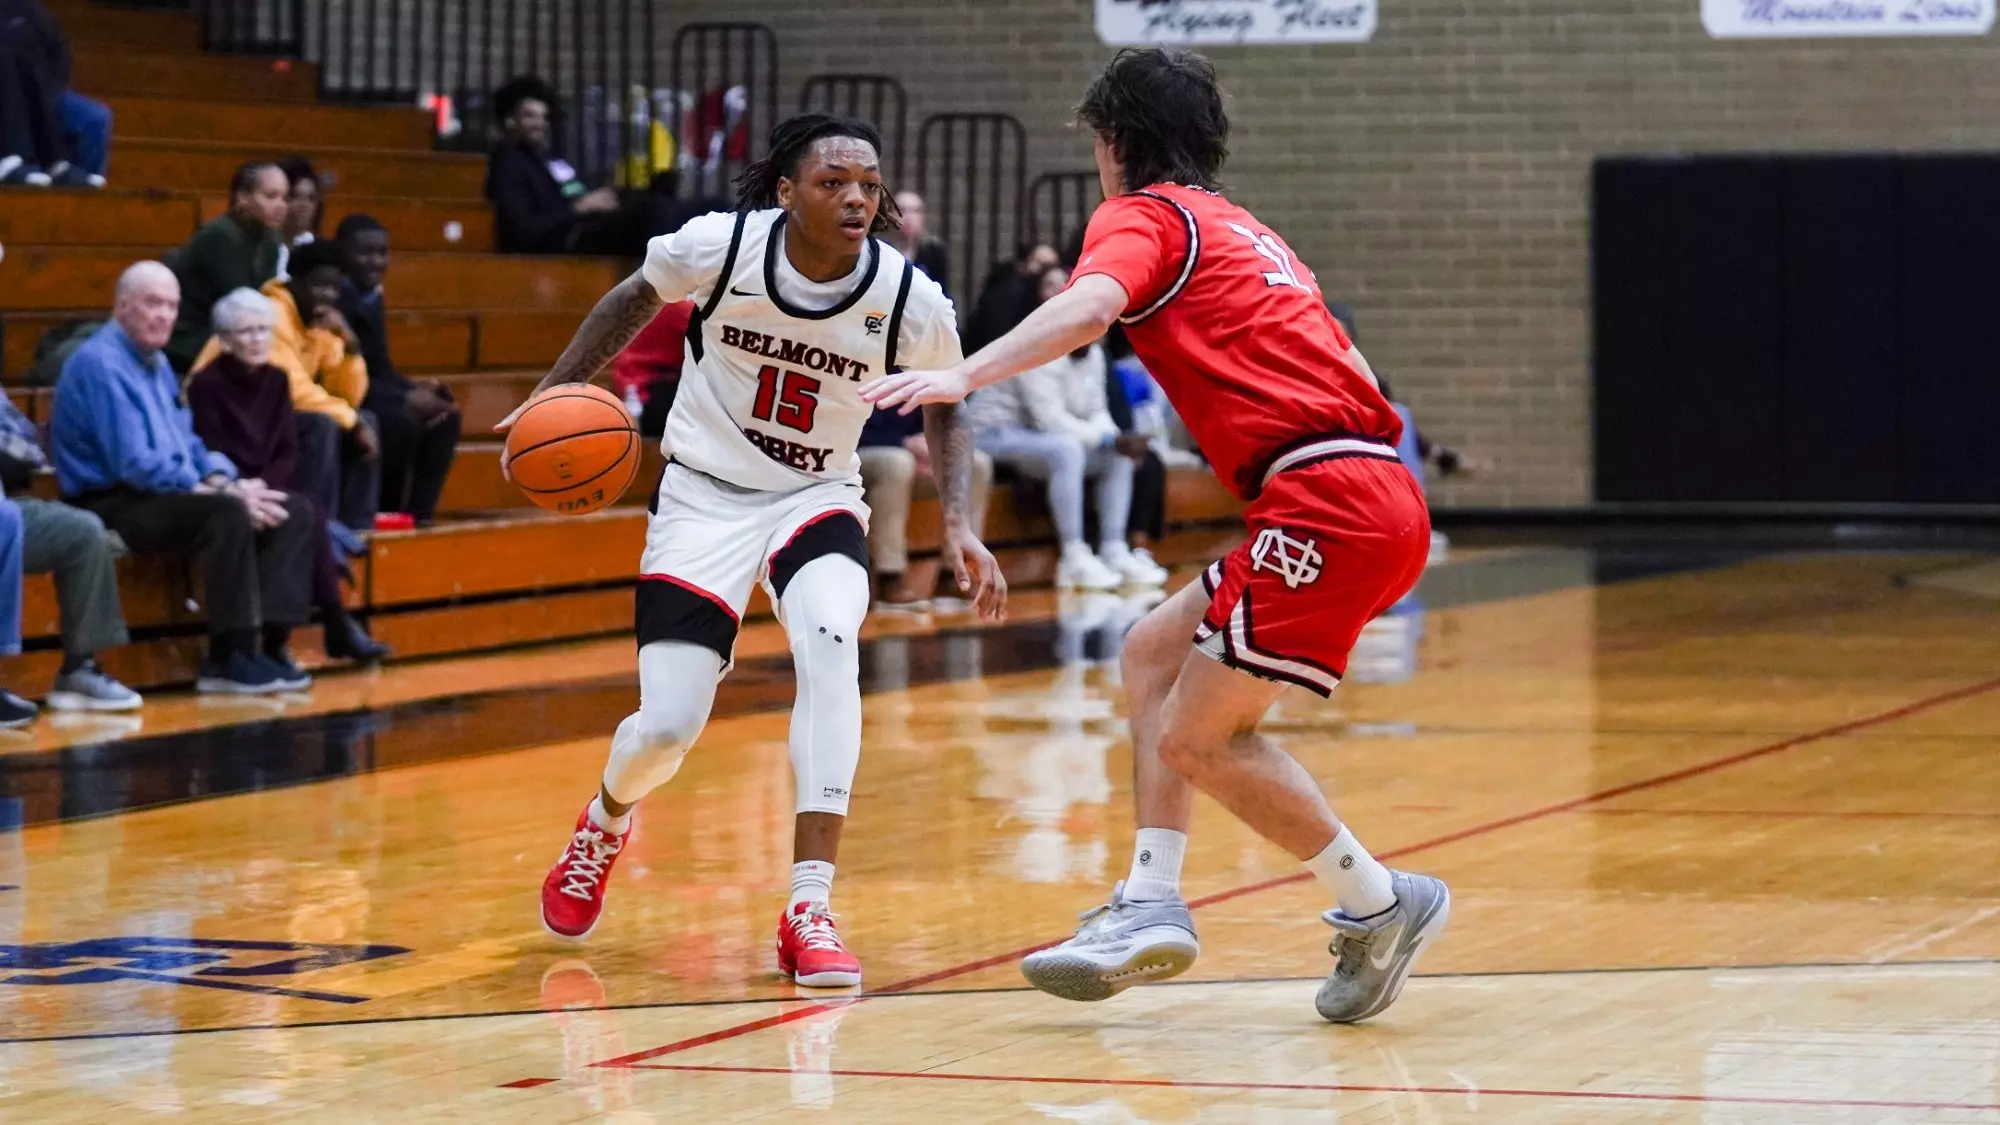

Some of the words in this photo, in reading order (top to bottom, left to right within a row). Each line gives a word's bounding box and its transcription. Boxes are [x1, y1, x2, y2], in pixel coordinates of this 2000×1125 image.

[720, 325, 869, 382] BELMONT
[751, 364, 821, 434] 15
[743, 427, 834, 472] BBEY
